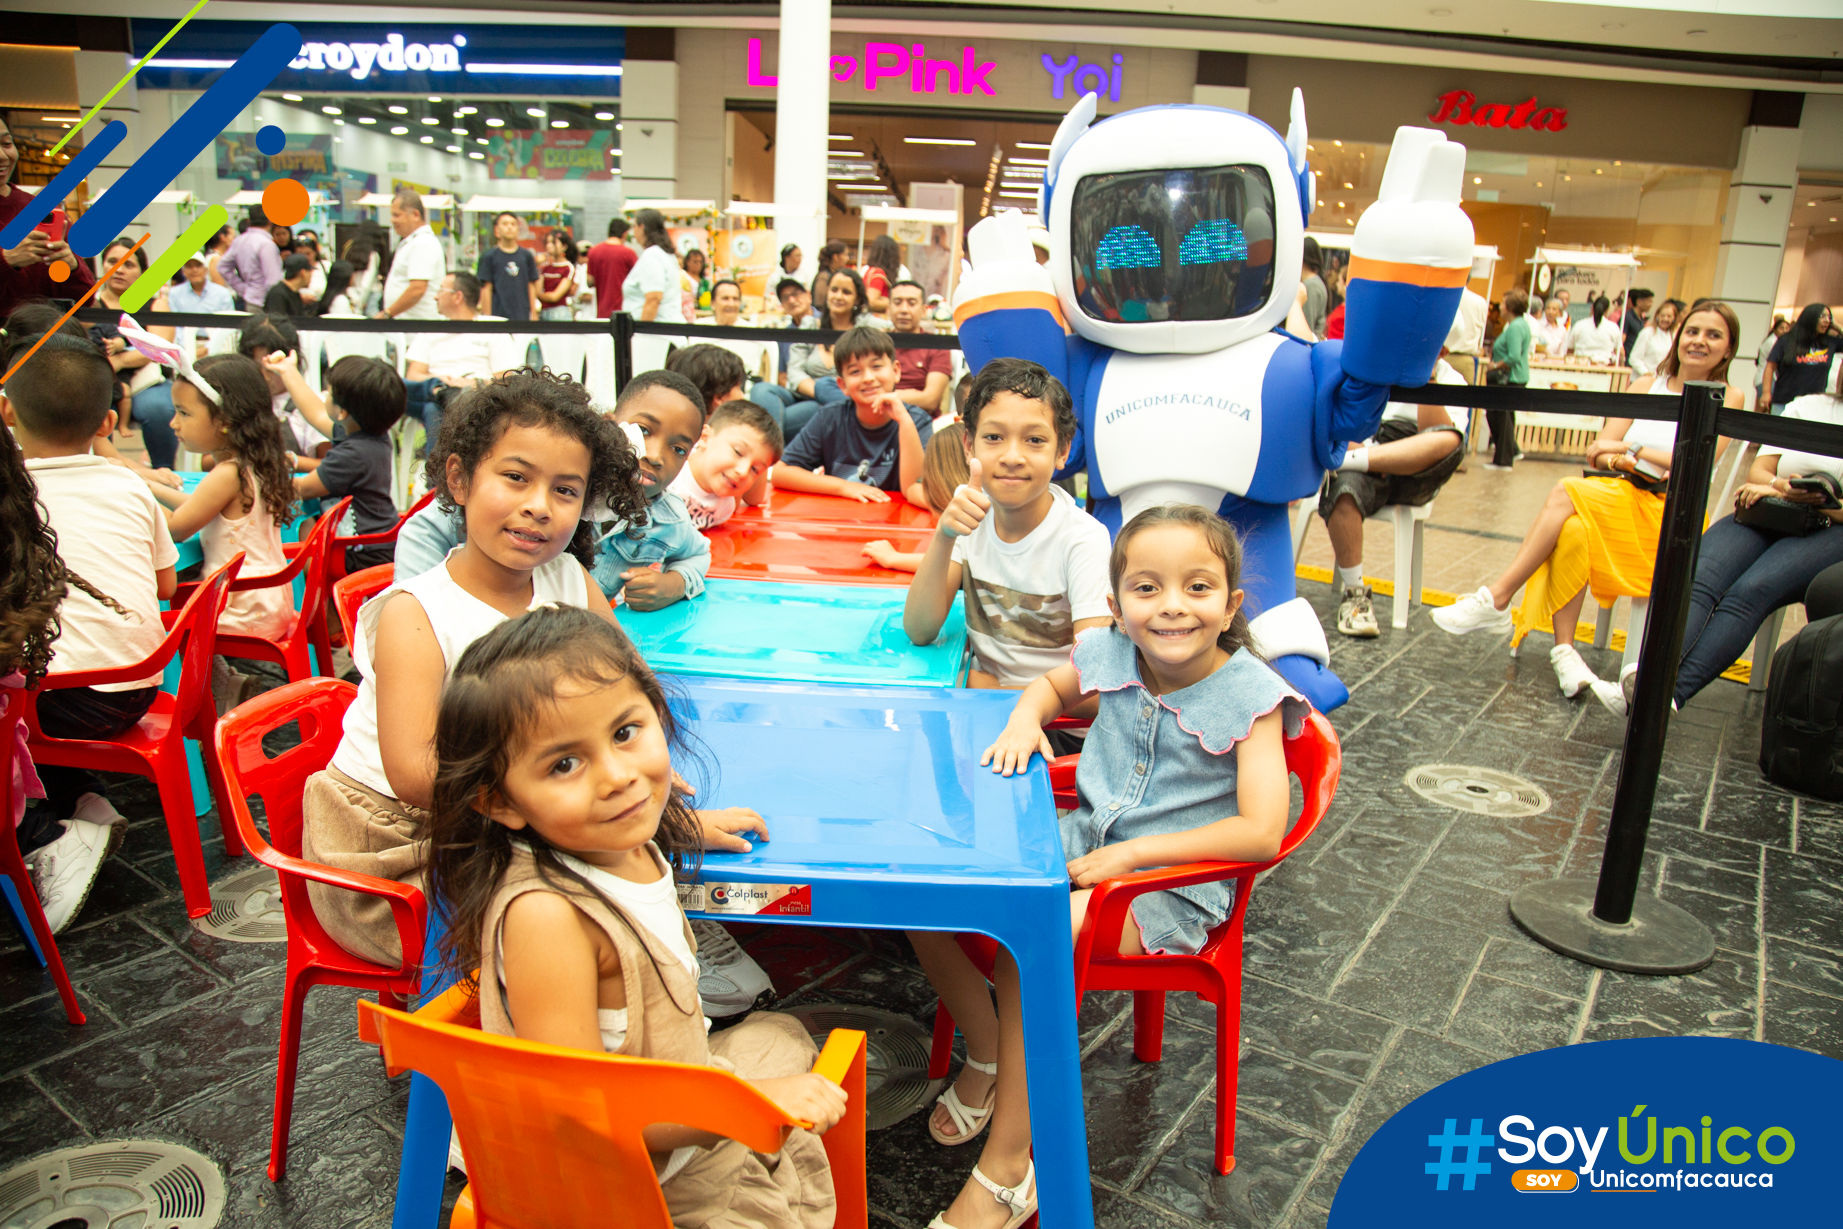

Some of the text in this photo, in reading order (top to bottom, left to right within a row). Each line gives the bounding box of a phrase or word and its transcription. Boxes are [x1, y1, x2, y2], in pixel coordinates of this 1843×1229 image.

[864, 42, 997, 96] Pink
[1041, 53, 1124, 102] Yoi
[1427, 90, 1569, 132] Bata
[1105, 394, 1251, 424] UNICOMFACAUCA
[726, 888, 768, 901] Colplast
